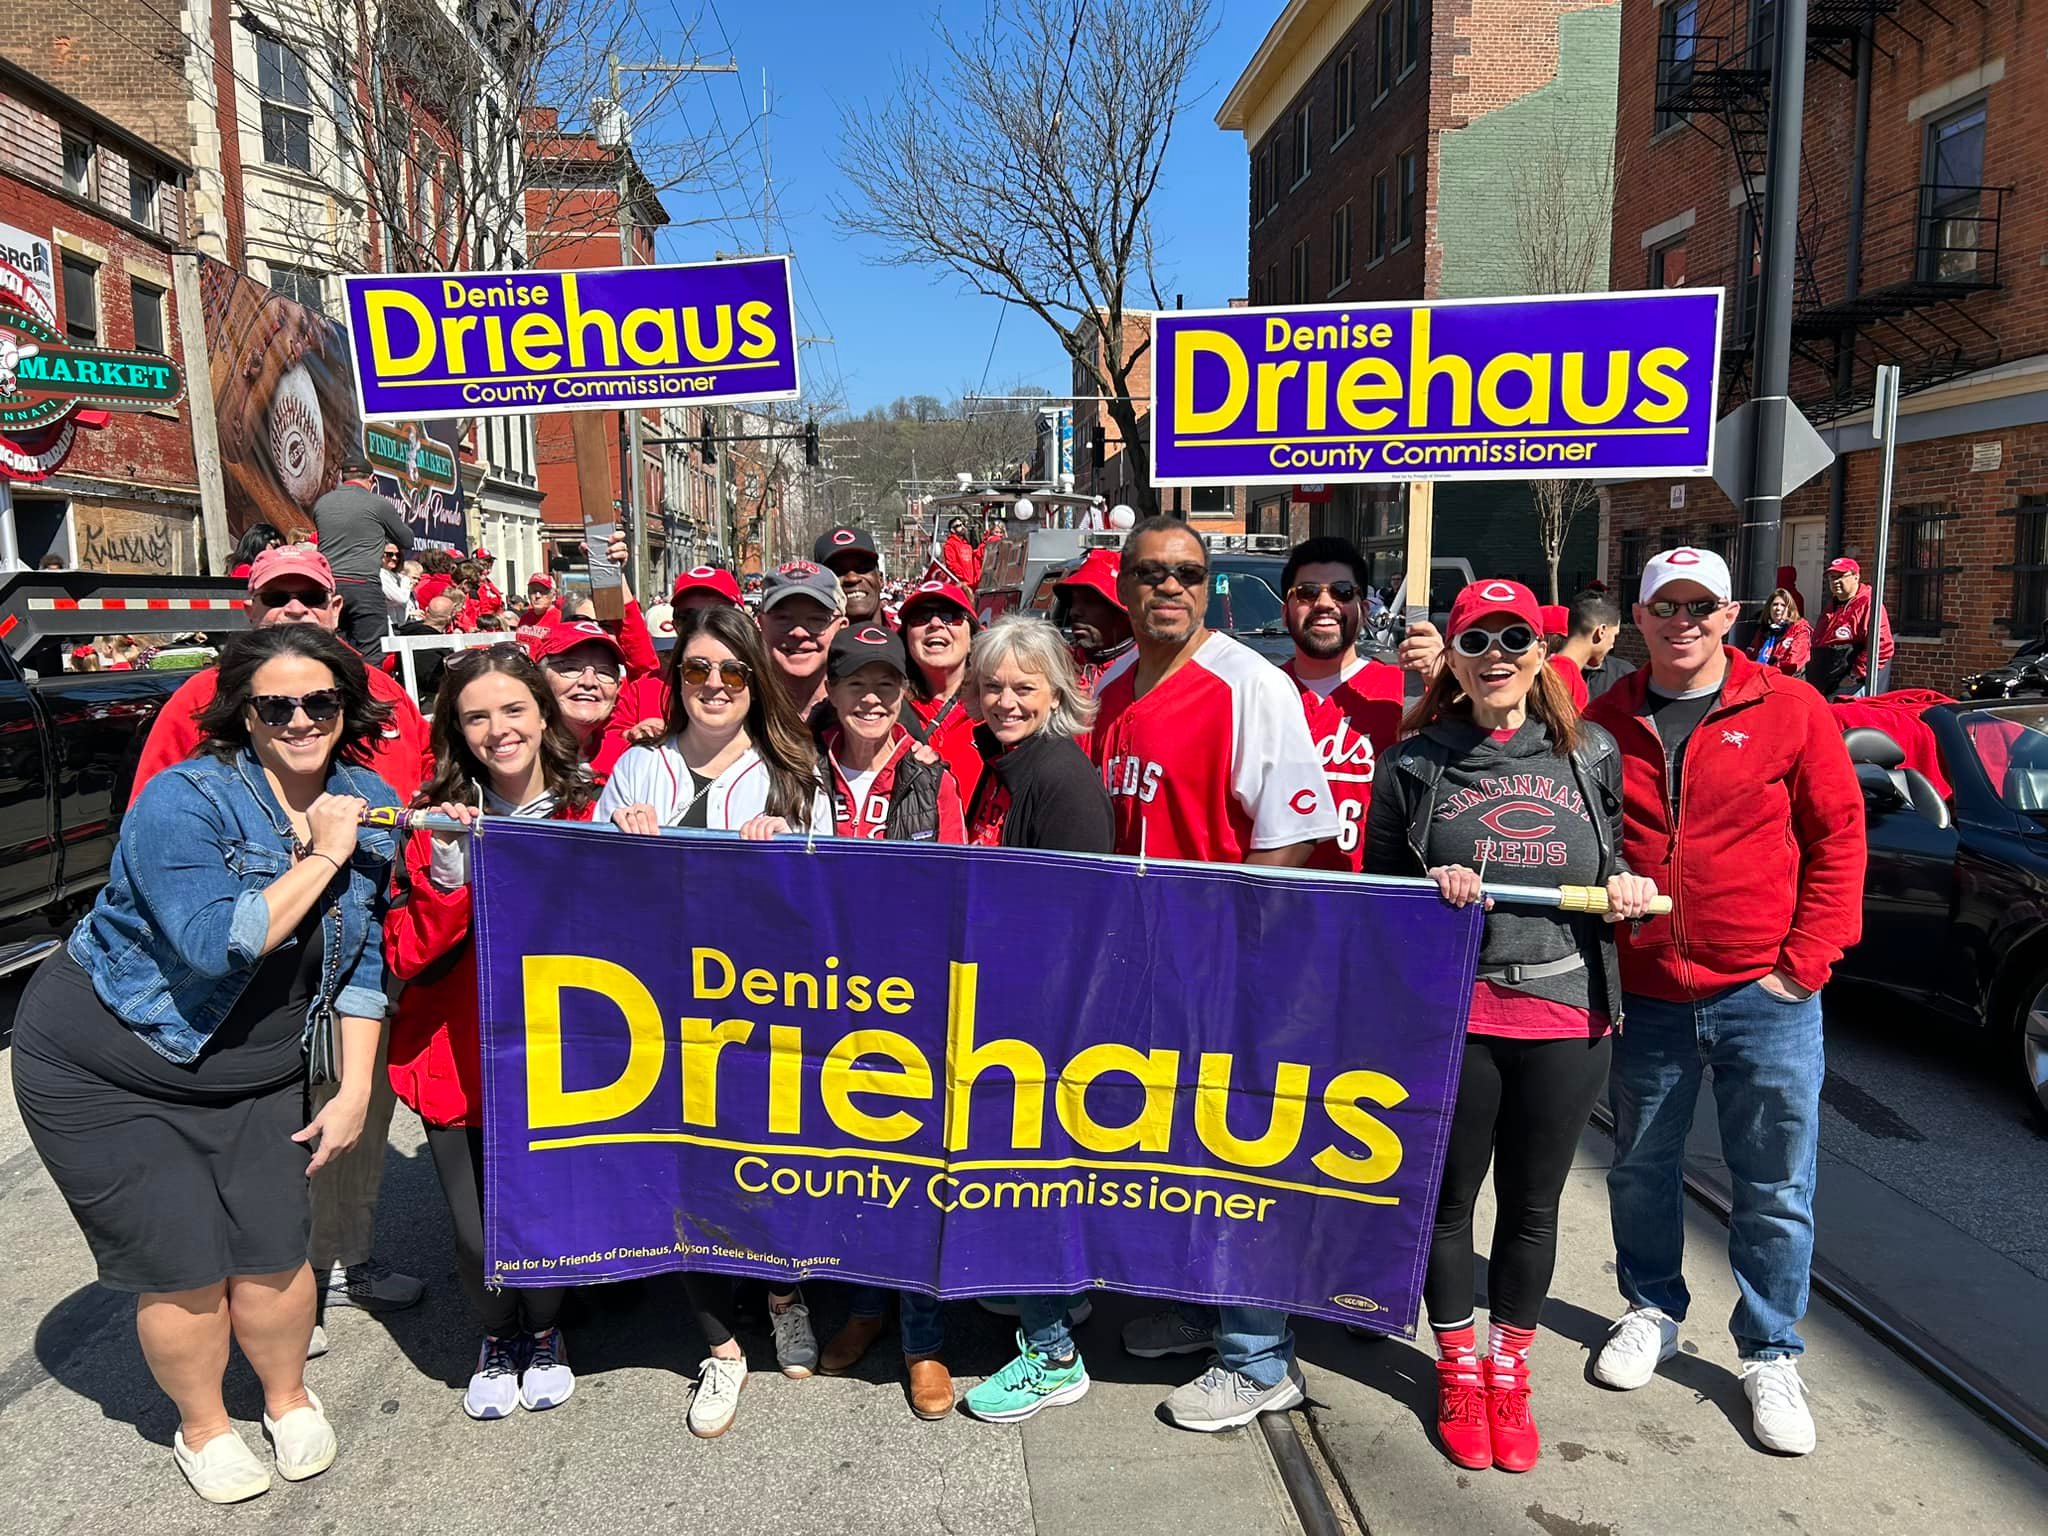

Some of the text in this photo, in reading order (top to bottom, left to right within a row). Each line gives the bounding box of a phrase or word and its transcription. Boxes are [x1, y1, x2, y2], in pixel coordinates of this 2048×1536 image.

[443, 278, 549, 309] Denise
[9, 315, 49, 341] 1852
[364, 272, 777, 377] Driehaus
[1265, 314, 1393, 352] Denise
[17, 356, 170, 389] MARKET
[1174, 308, 1689, 435] Driehaus
[462, 375, 717, 403] County Commissioner
[4, 400, 56, 421] NNATI
[417, 450, 452, 477] MARKET
[1269, 438, 1598, 470] County Commissioner
[1317, 716, 1374, 772] ds
[1108, 755, 1163, 803] EDS
[834, 794, 890, 824] ED
[1473, 840, 1567, 866] REDS
[692, 947, 915, 1014] Denise
[522, 954, 1409, 1184] Driehaus
[734, 1156, 1276, 1222] County Commissioner
[495, 1242, 841, 1271] Paid for by Friends of Driehaus, Alyson Steele Beridon, Treasurer
